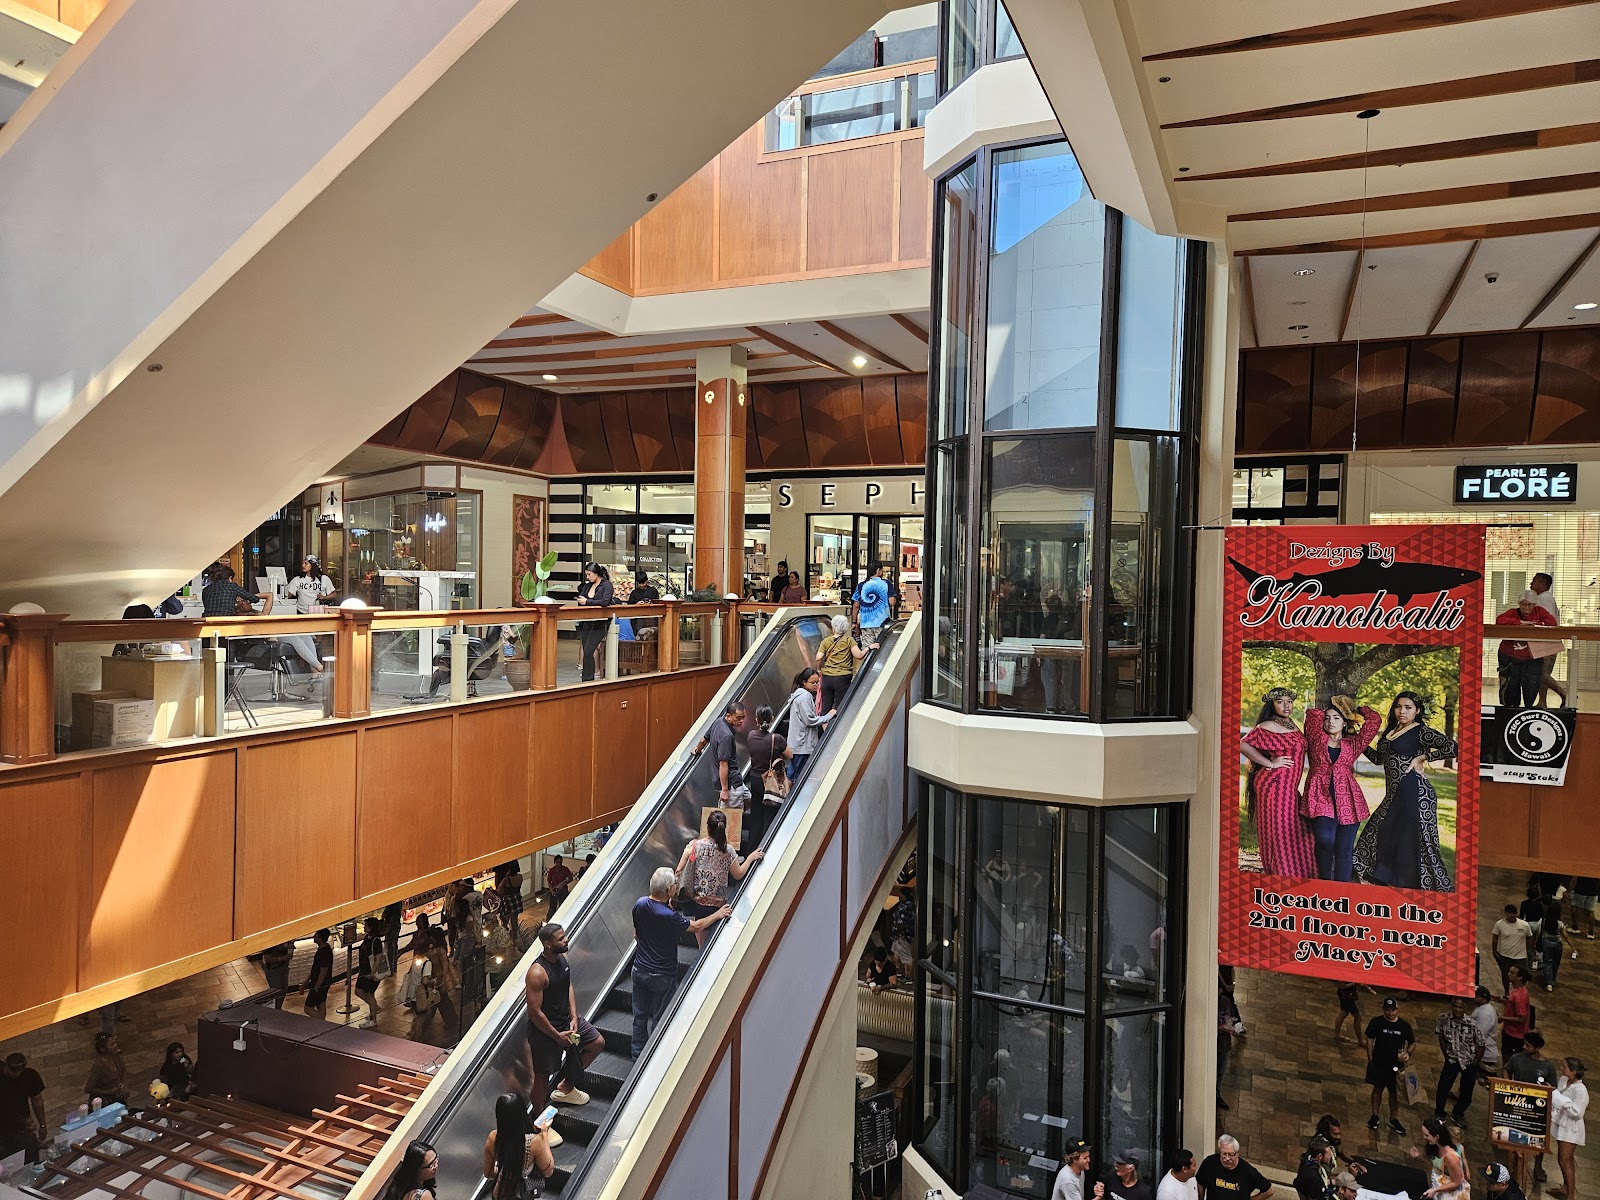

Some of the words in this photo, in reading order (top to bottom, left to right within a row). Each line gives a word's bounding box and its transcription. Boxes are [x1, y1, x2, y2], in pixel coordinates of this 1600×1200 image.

[1462, 472, 1571, 498] FLORÉ
[1486, 468, 1526, 478] PEARL
[1529, 468, 1548, 477] DE
[778, 482, 926, 507] SEPH
[1290, 541, 1364, 567] Dezigns
[1368, 541, 1395, 568] By
[1240, 575, 1465, 631] Kamohoalii
[1509, 720, 1521, 735] T&C
[1520, 713, 1540, 722] Surf
[1541, 714, 1563, 737] Designs
[1520, 750, 1551, 760] Hawaii
[1503, 770, 1525, 778] stay
[1253, 888, 1350, 915] Located
[1355, 902, 1392, 919] on
[1398, 902, 1443, 924] the
[1249, 910, 1297, 932] 2nd
[1302, 916, 1377, 943] floor,
[1382, 928, 1448, 949] near
[1295, 940, 1397, 970] Macy's
